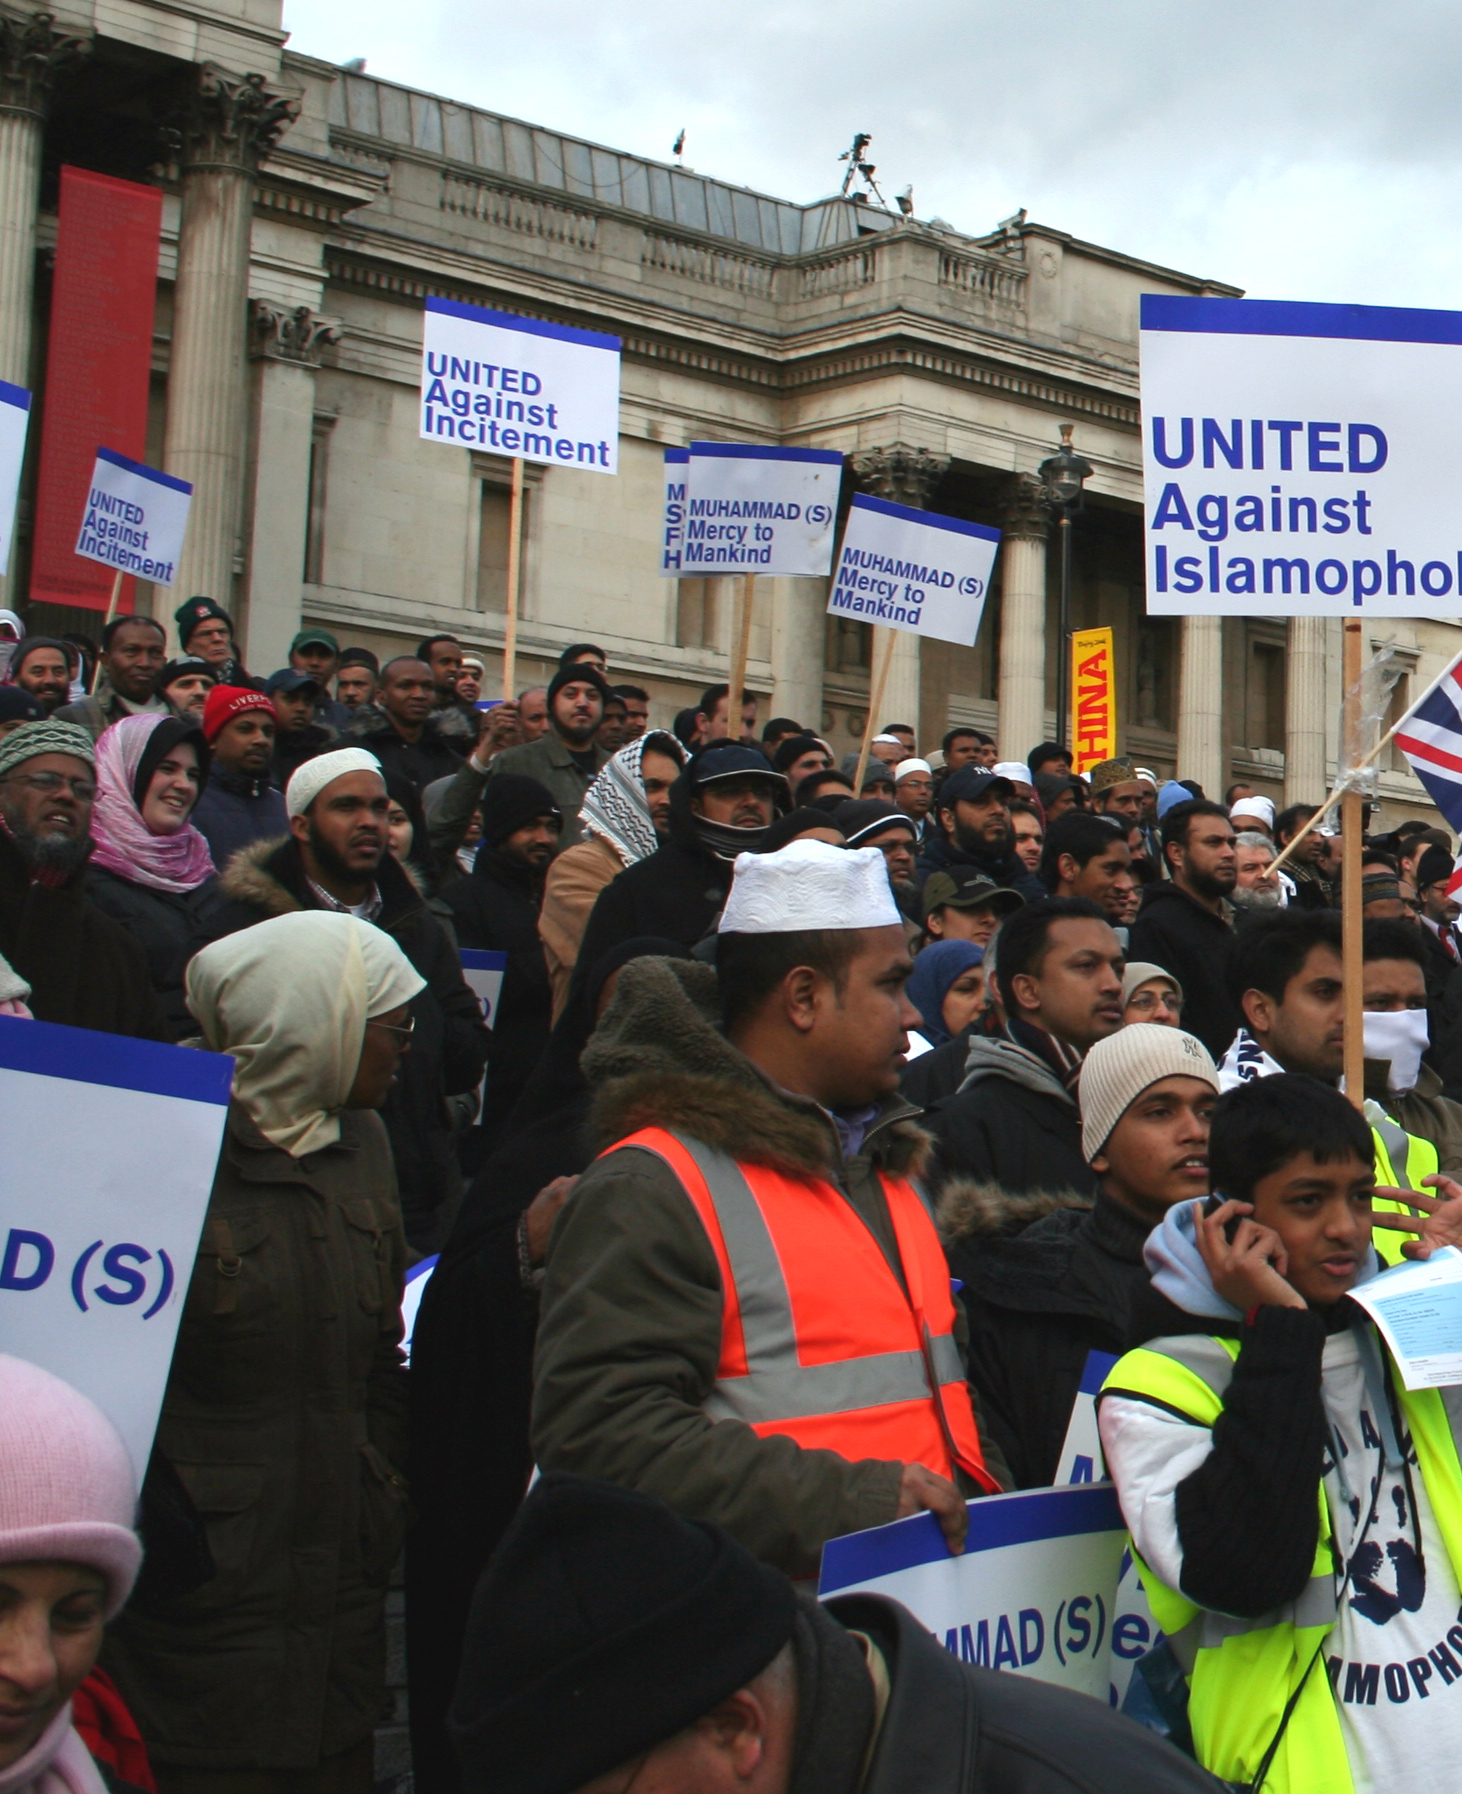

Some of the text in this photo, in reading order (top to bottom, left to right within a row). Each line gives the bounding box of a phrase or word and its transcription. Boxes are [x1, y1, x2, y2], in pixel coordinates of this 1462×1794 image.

[427, 351, 542, 396] UNITED
[425, 378, 558, 429] Against
[425, 405, 610, 467] Incitement
[1151, 416, 1388, 473] UNITED
[84, 508, 149, 551] Against
[89, 488, 144, 525] UNITED
[688, 519, 774, 544] Mercy to
[690, 499, 833, 526] MUHAMMAD (S)
[1151, 483, 1372, 542] Against
[79, 528, 174, 582] Incitement
[685, 542, 772, 564] Mankind
[843, 547, 984, 598] MUHAMMAD (S)
[832, 587, 922, 625] Mankind
[837, 566, 925, 604] Mercy to
[1077, 649, 1109, 775] HINA
[71, 1239, 174, 1320] (S)
[1054, 1593, 1106, 1667] (S)
